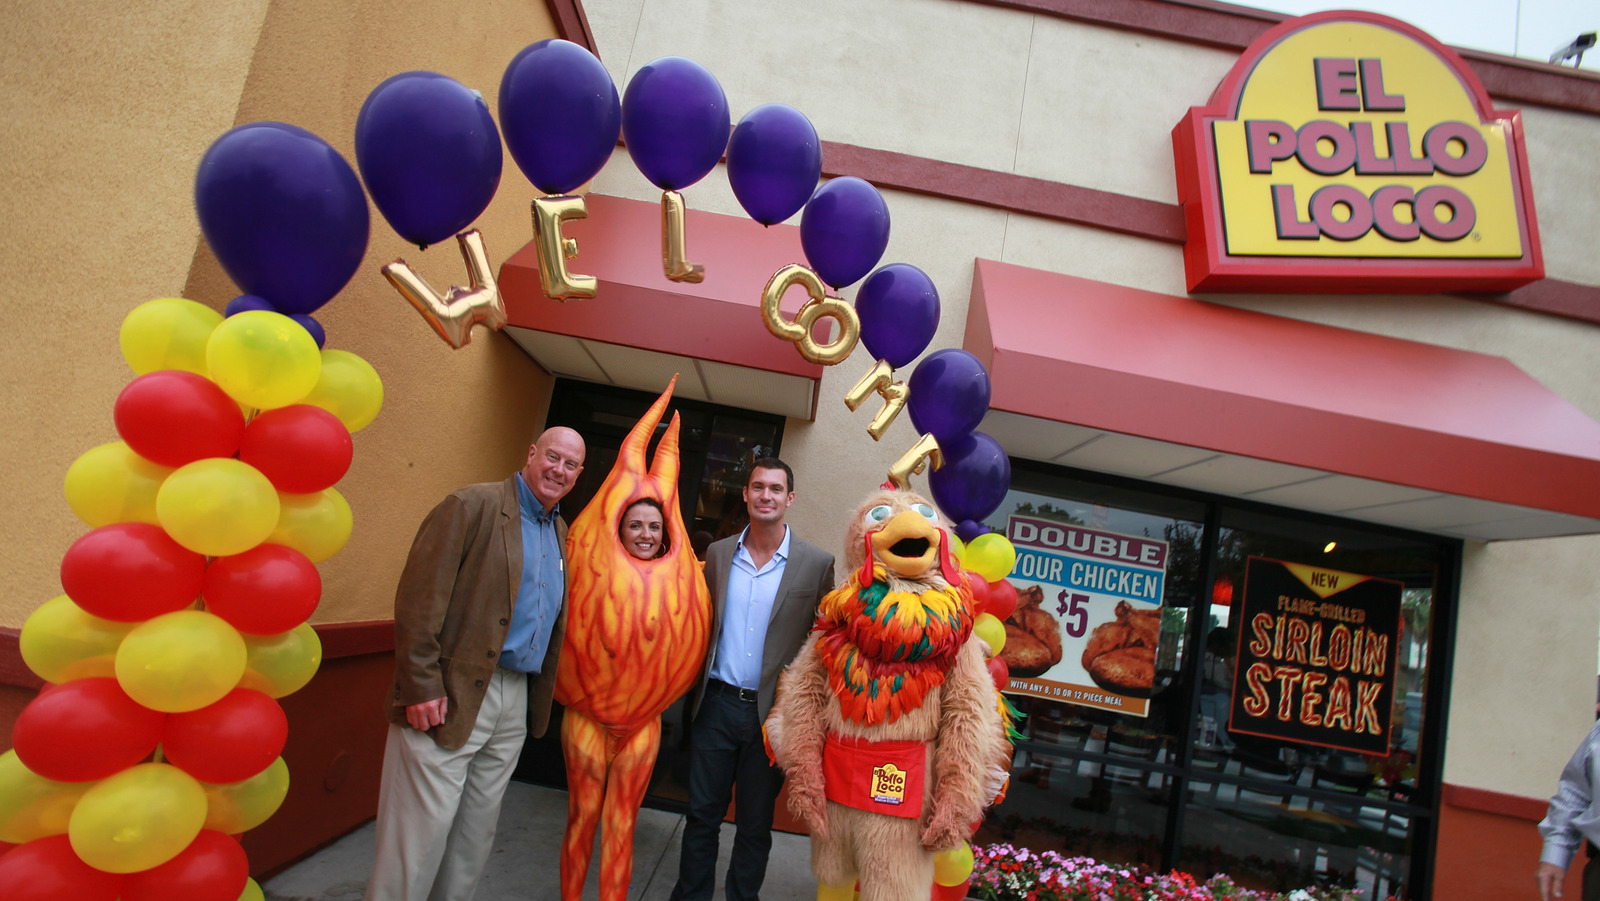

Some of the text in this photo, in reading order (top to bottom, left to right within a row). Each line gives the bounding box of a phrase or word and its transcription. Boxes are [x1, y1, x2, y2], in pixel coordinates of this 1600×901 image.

[1313, 57, 1406, 112] EL
[1244, 119, 1488, 177] POLLO
[1270, 184, 1477, 243] LOCO
[1013, 521, 1160, 565] DOUBLE
[1011, 551, 1158, 600] YOUR CHICKEN
[1310, 571, 1340, 590] NEW
[1056, 588, 1091, 639] $5
[1250, 611, 1389, 678] SIRLOIN
[1010, 680, 1122, 706] WITH ANY 8, 10 OR 12 PIECE MEAL
[1242, 660, 1384, 736] STEAK
[876, 781, 902, 793] Loco
[877, 769, 904, 784] Pollo
